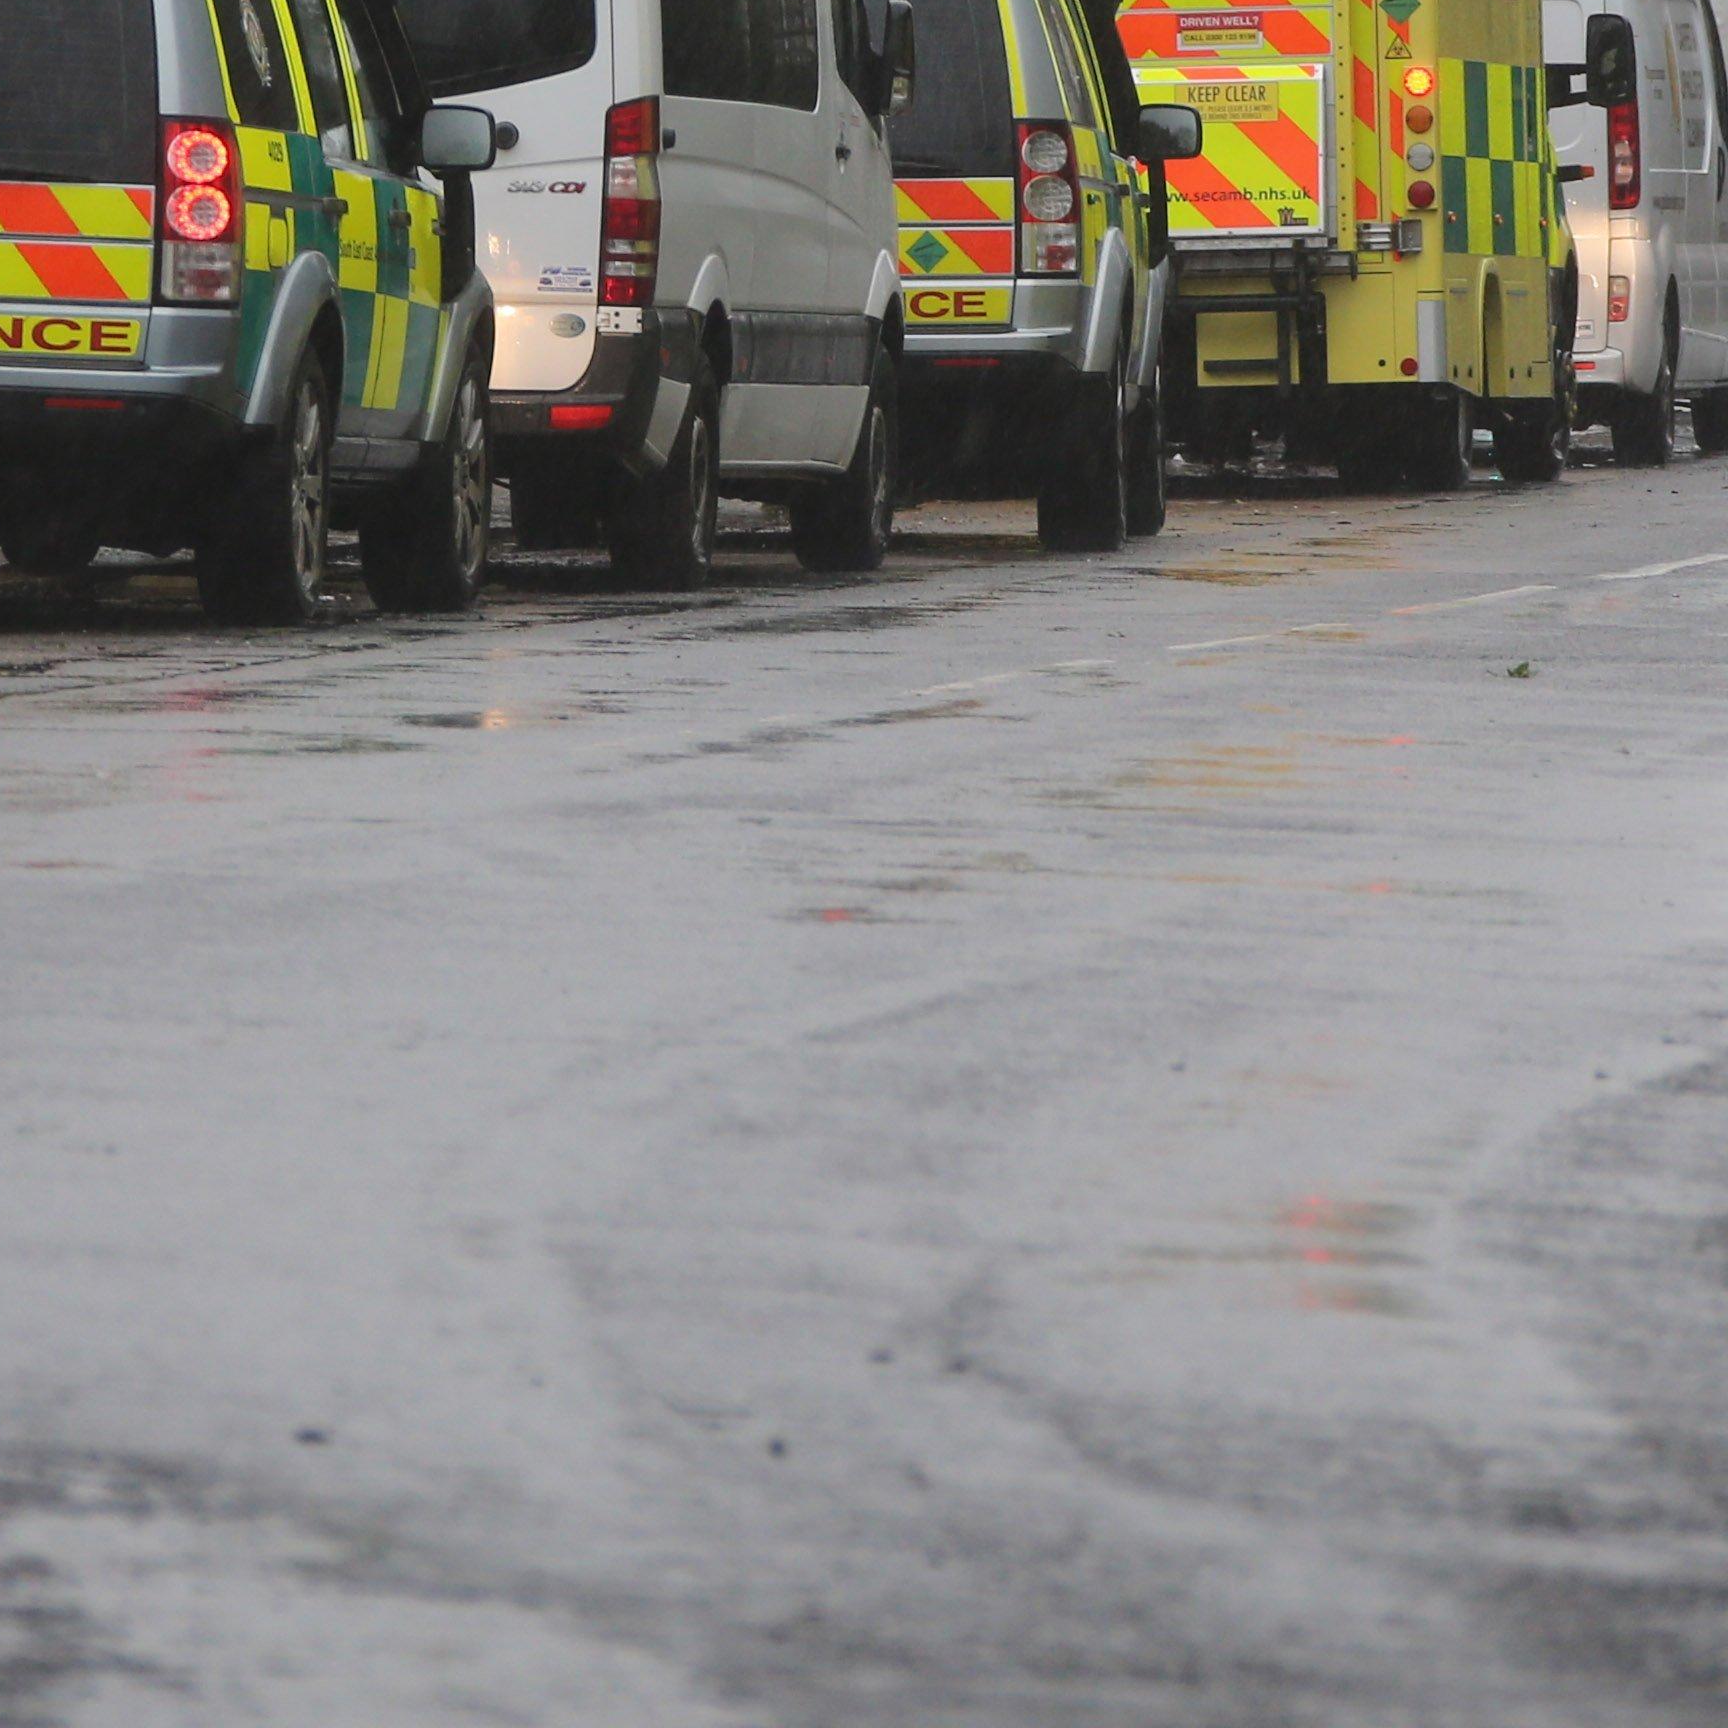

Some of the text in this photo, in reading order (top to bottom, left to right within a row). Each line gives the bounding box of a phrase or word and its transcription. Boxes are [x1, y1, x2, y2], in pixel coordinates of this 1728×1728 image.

[1180, 15, 1260, 27] DRIVEN WELL?
[1183, 33, 1203, 42] CALL
[1187, 85, 1266, 103] KEEP CLEAR
[548, 181, 587, 194] CDI
